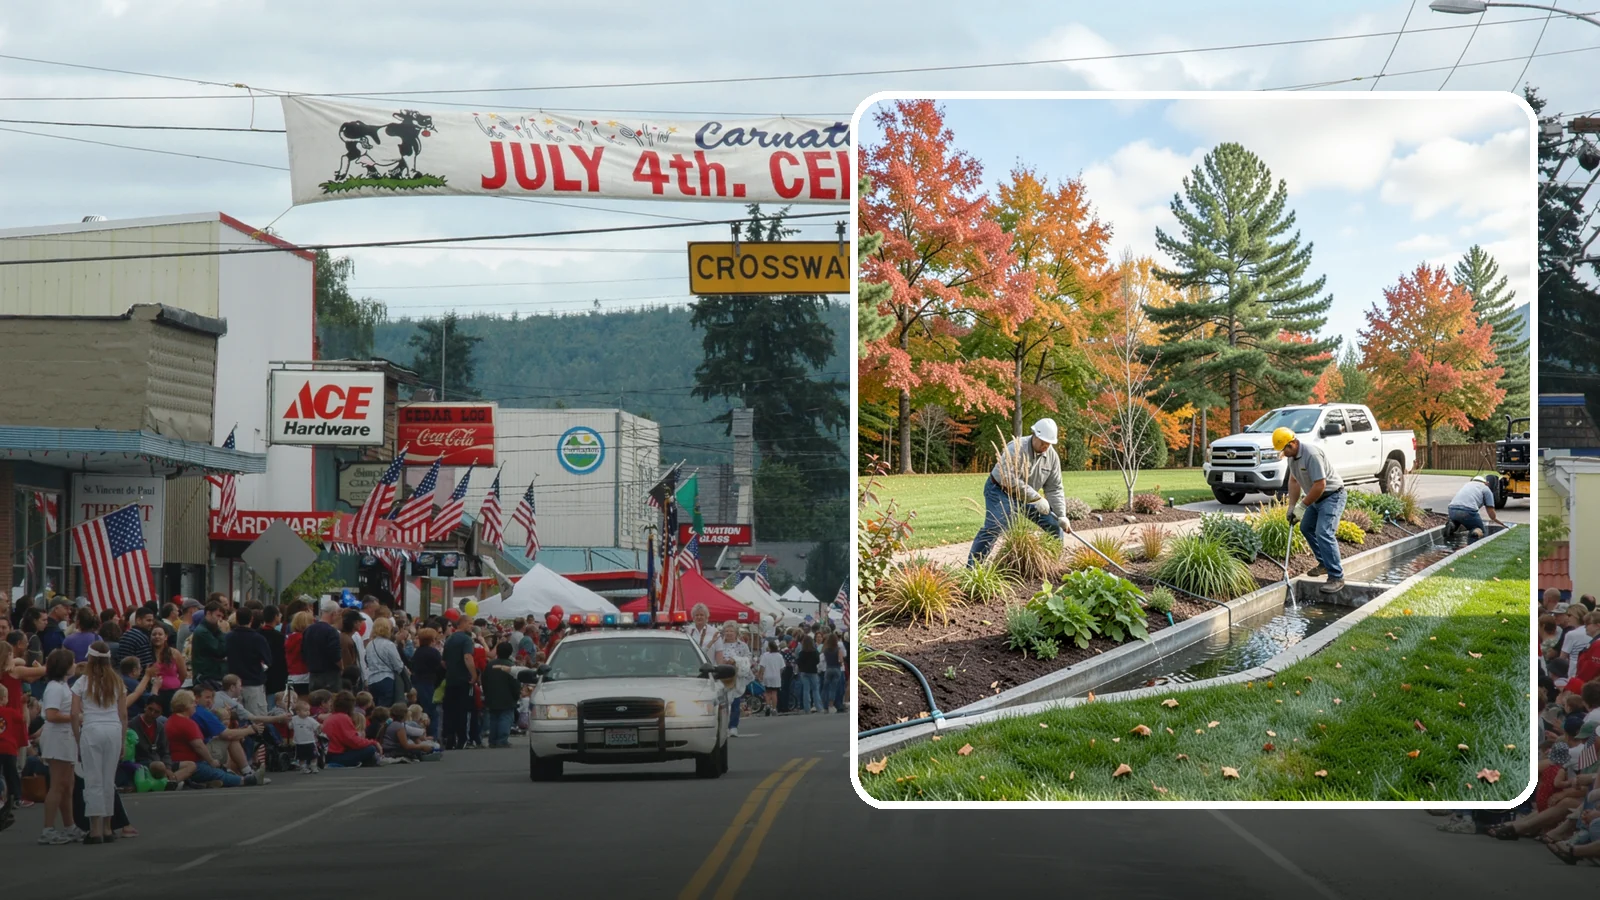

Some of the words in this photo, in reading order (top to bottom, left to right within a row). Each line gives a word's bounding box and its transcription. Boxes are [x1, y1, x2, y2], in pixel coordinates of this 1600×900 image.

[481, 141, 604, 192] JULY
[633, 150, 746, 197] 4th.
[697, 254, 850, 280] CROSSWA
[282, 380, 373, 420] ACE
[406, 409, 452, 422] CEDAR
[283, 421, 370, 436] Hardware
[416, 428, 477, 447] Coca-Cola
[353, 467, 386, 480] Simpl
[95, 485, 124, 494] Vincent
[126, 486, 135, 494] de
[137, 486, 155, 495] Paul
[688, 526, 741, 535] CRNATION
[699, 535, 730, 543] GLASS
